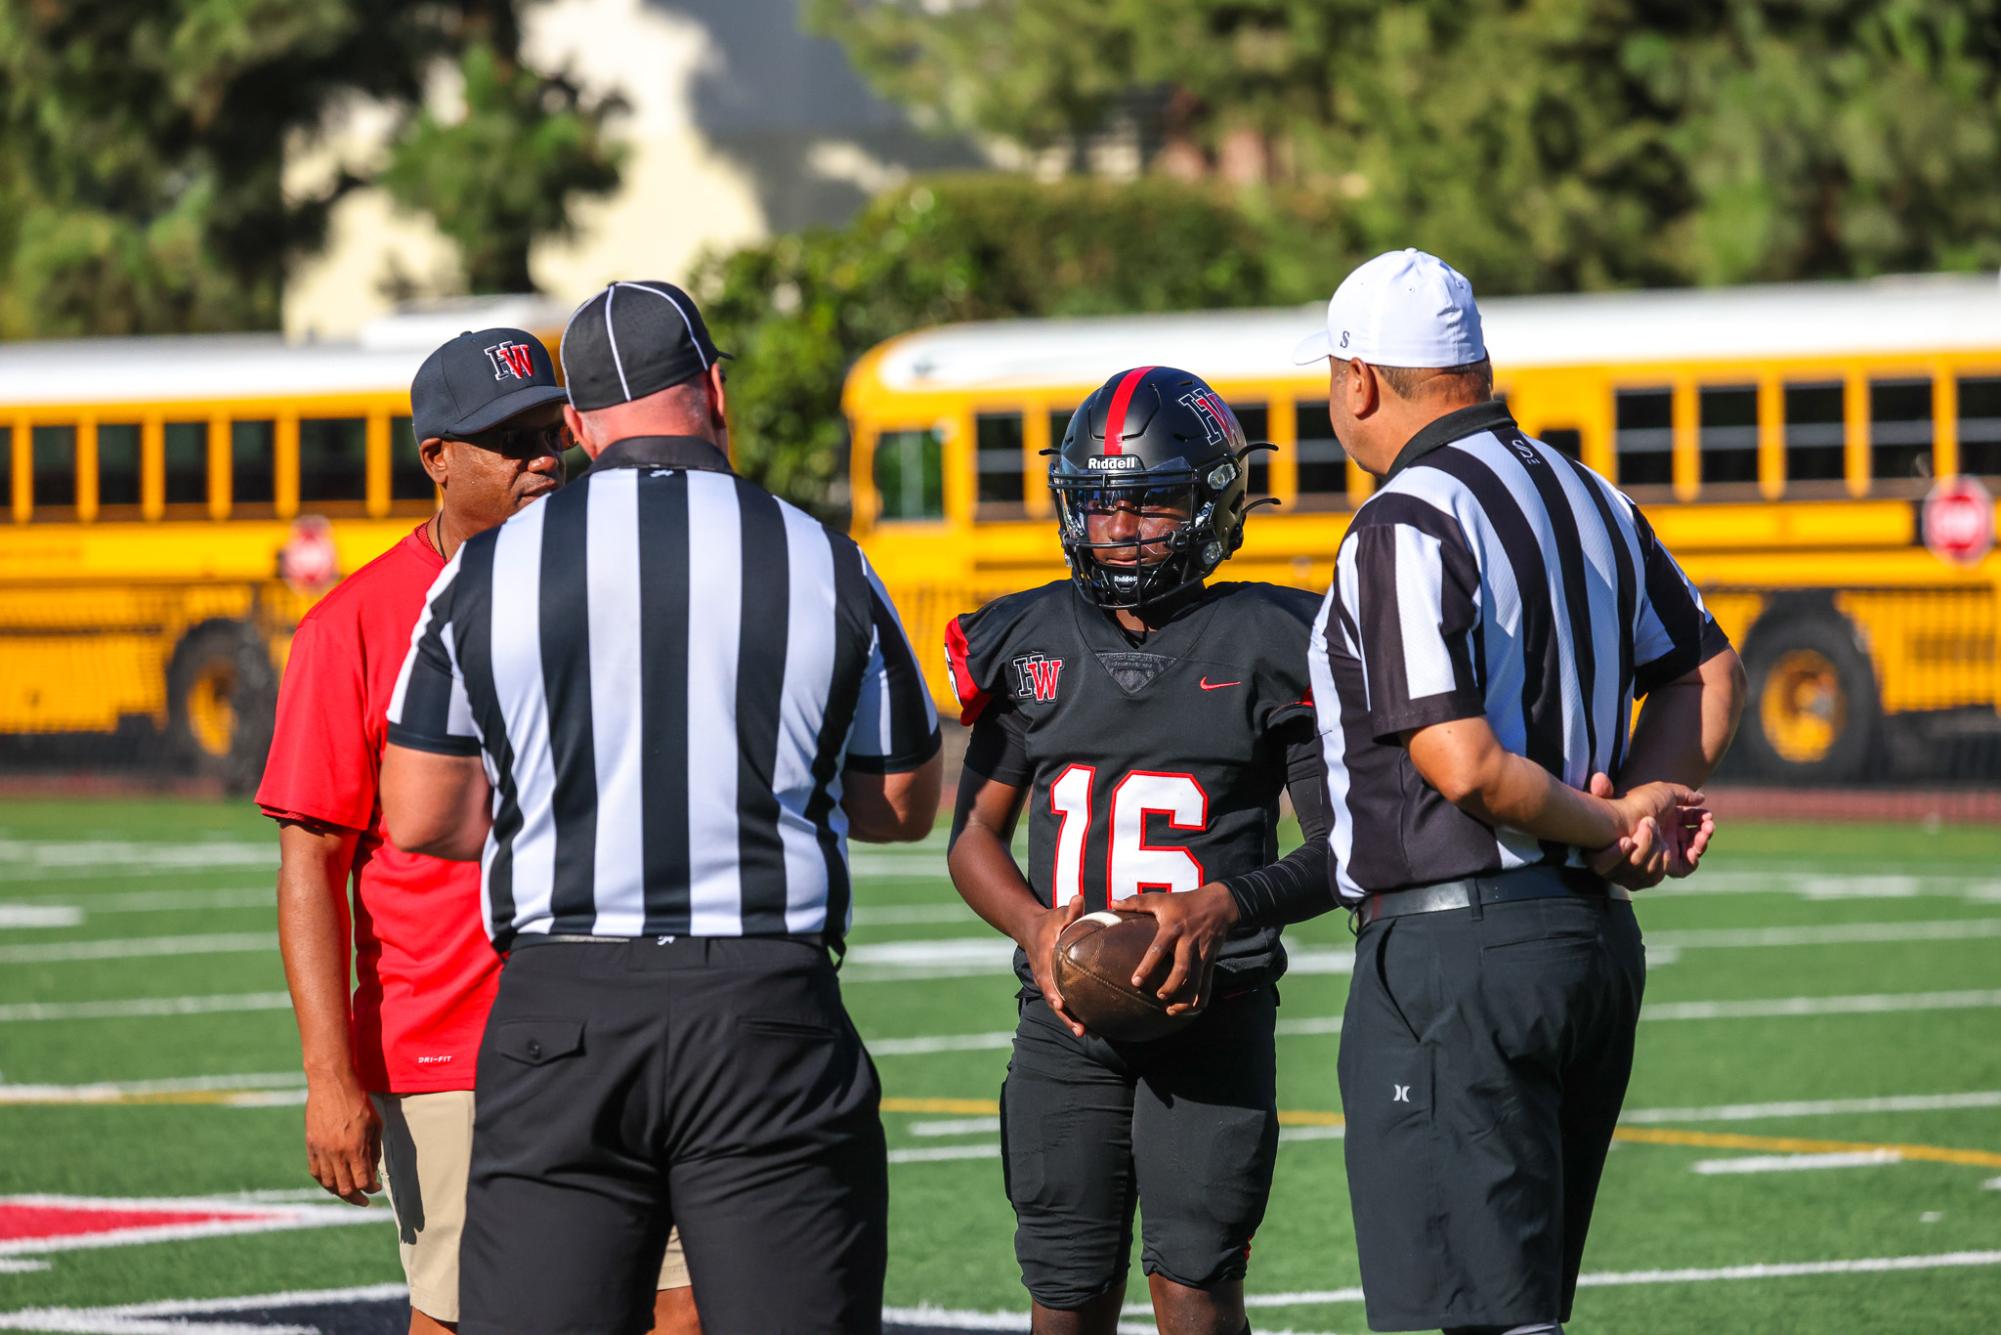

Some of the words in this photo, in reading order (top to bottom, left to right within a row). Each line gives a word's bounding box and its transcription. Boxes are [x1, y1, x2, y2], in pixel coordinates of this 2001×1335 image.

[484, 341, 534, 380] HW
[1088, 457, 1135, 469] Riddell
[1013, 655, 1062, 701] HW
[1050, 763, 1208, 910] 16
[418, 1055, 452, 1063] DRI-FIT
